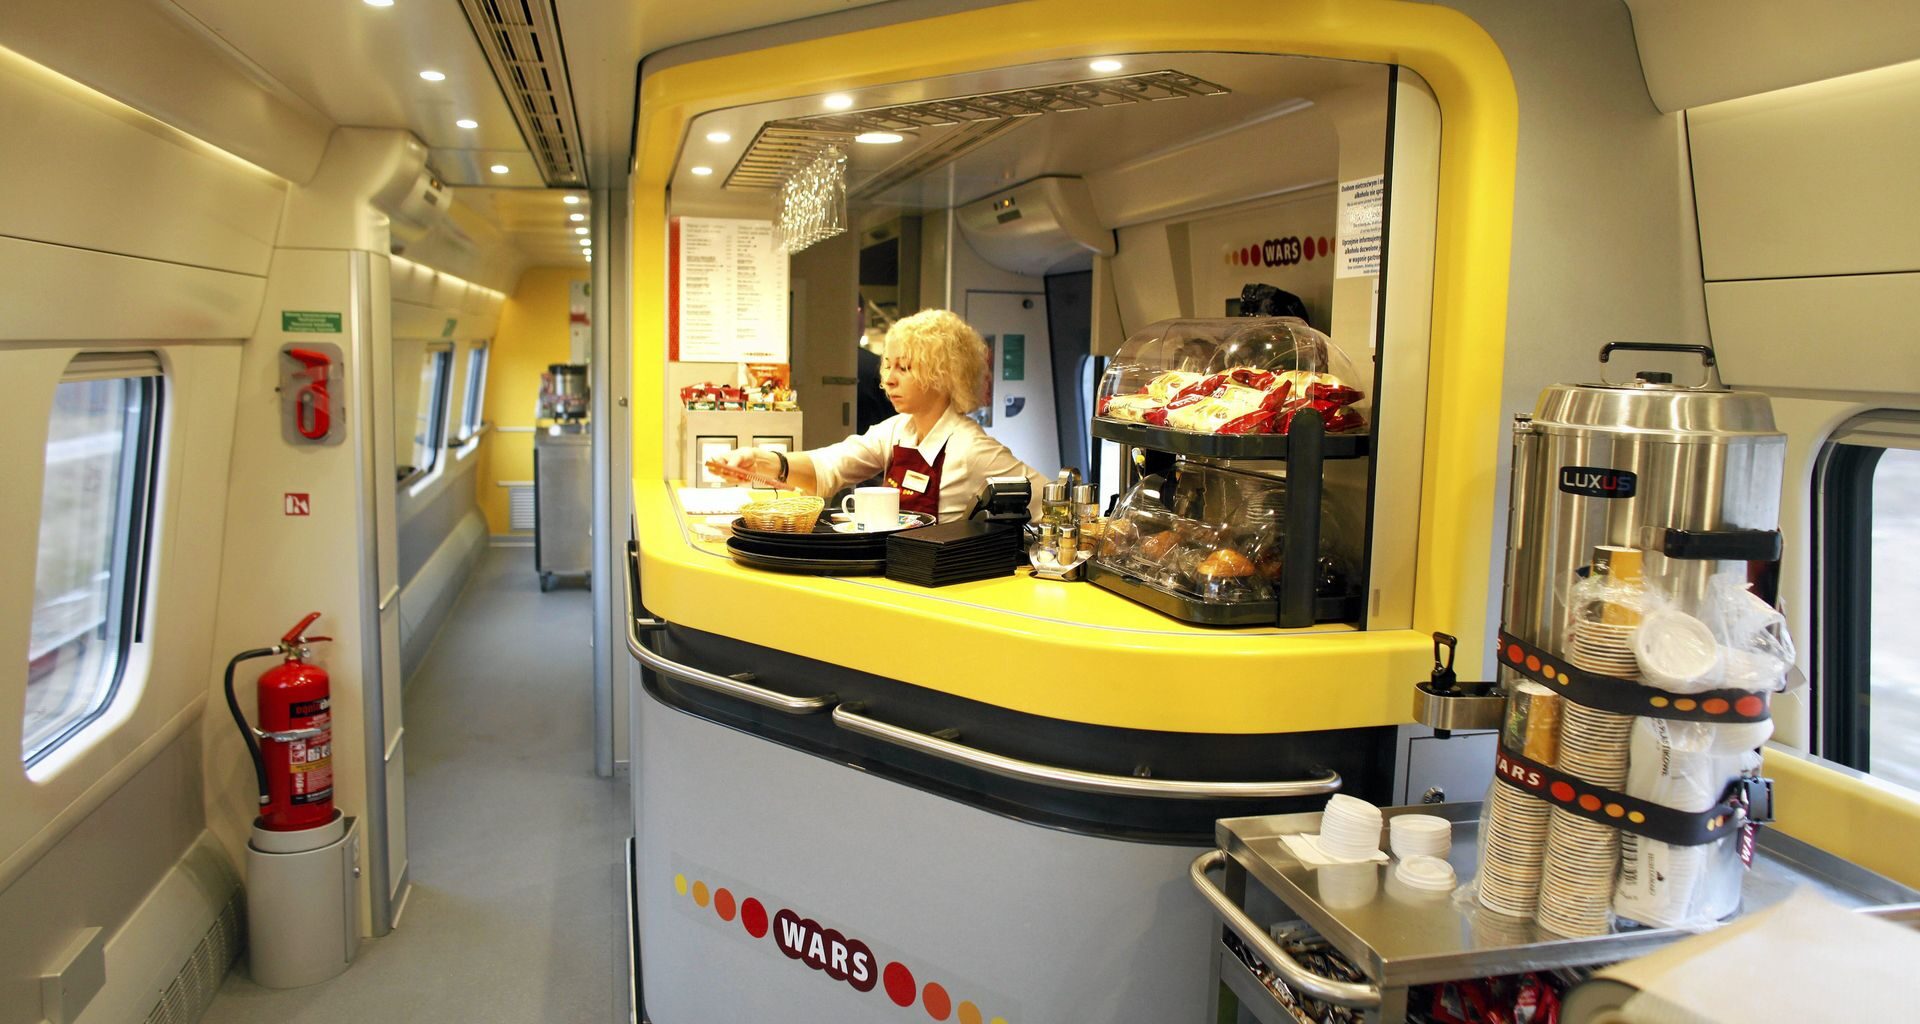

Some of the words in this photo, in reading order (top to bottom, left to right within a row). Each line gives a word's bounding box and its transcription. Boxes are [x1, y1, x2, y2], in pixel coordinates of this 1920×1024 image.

[1265, 242, 1299, 262] WARS
[1563, 471, 1632, 491] LUXUS
[1741, 823, 1753, 862] WAR
[781, 917, 869, 982] WARS
